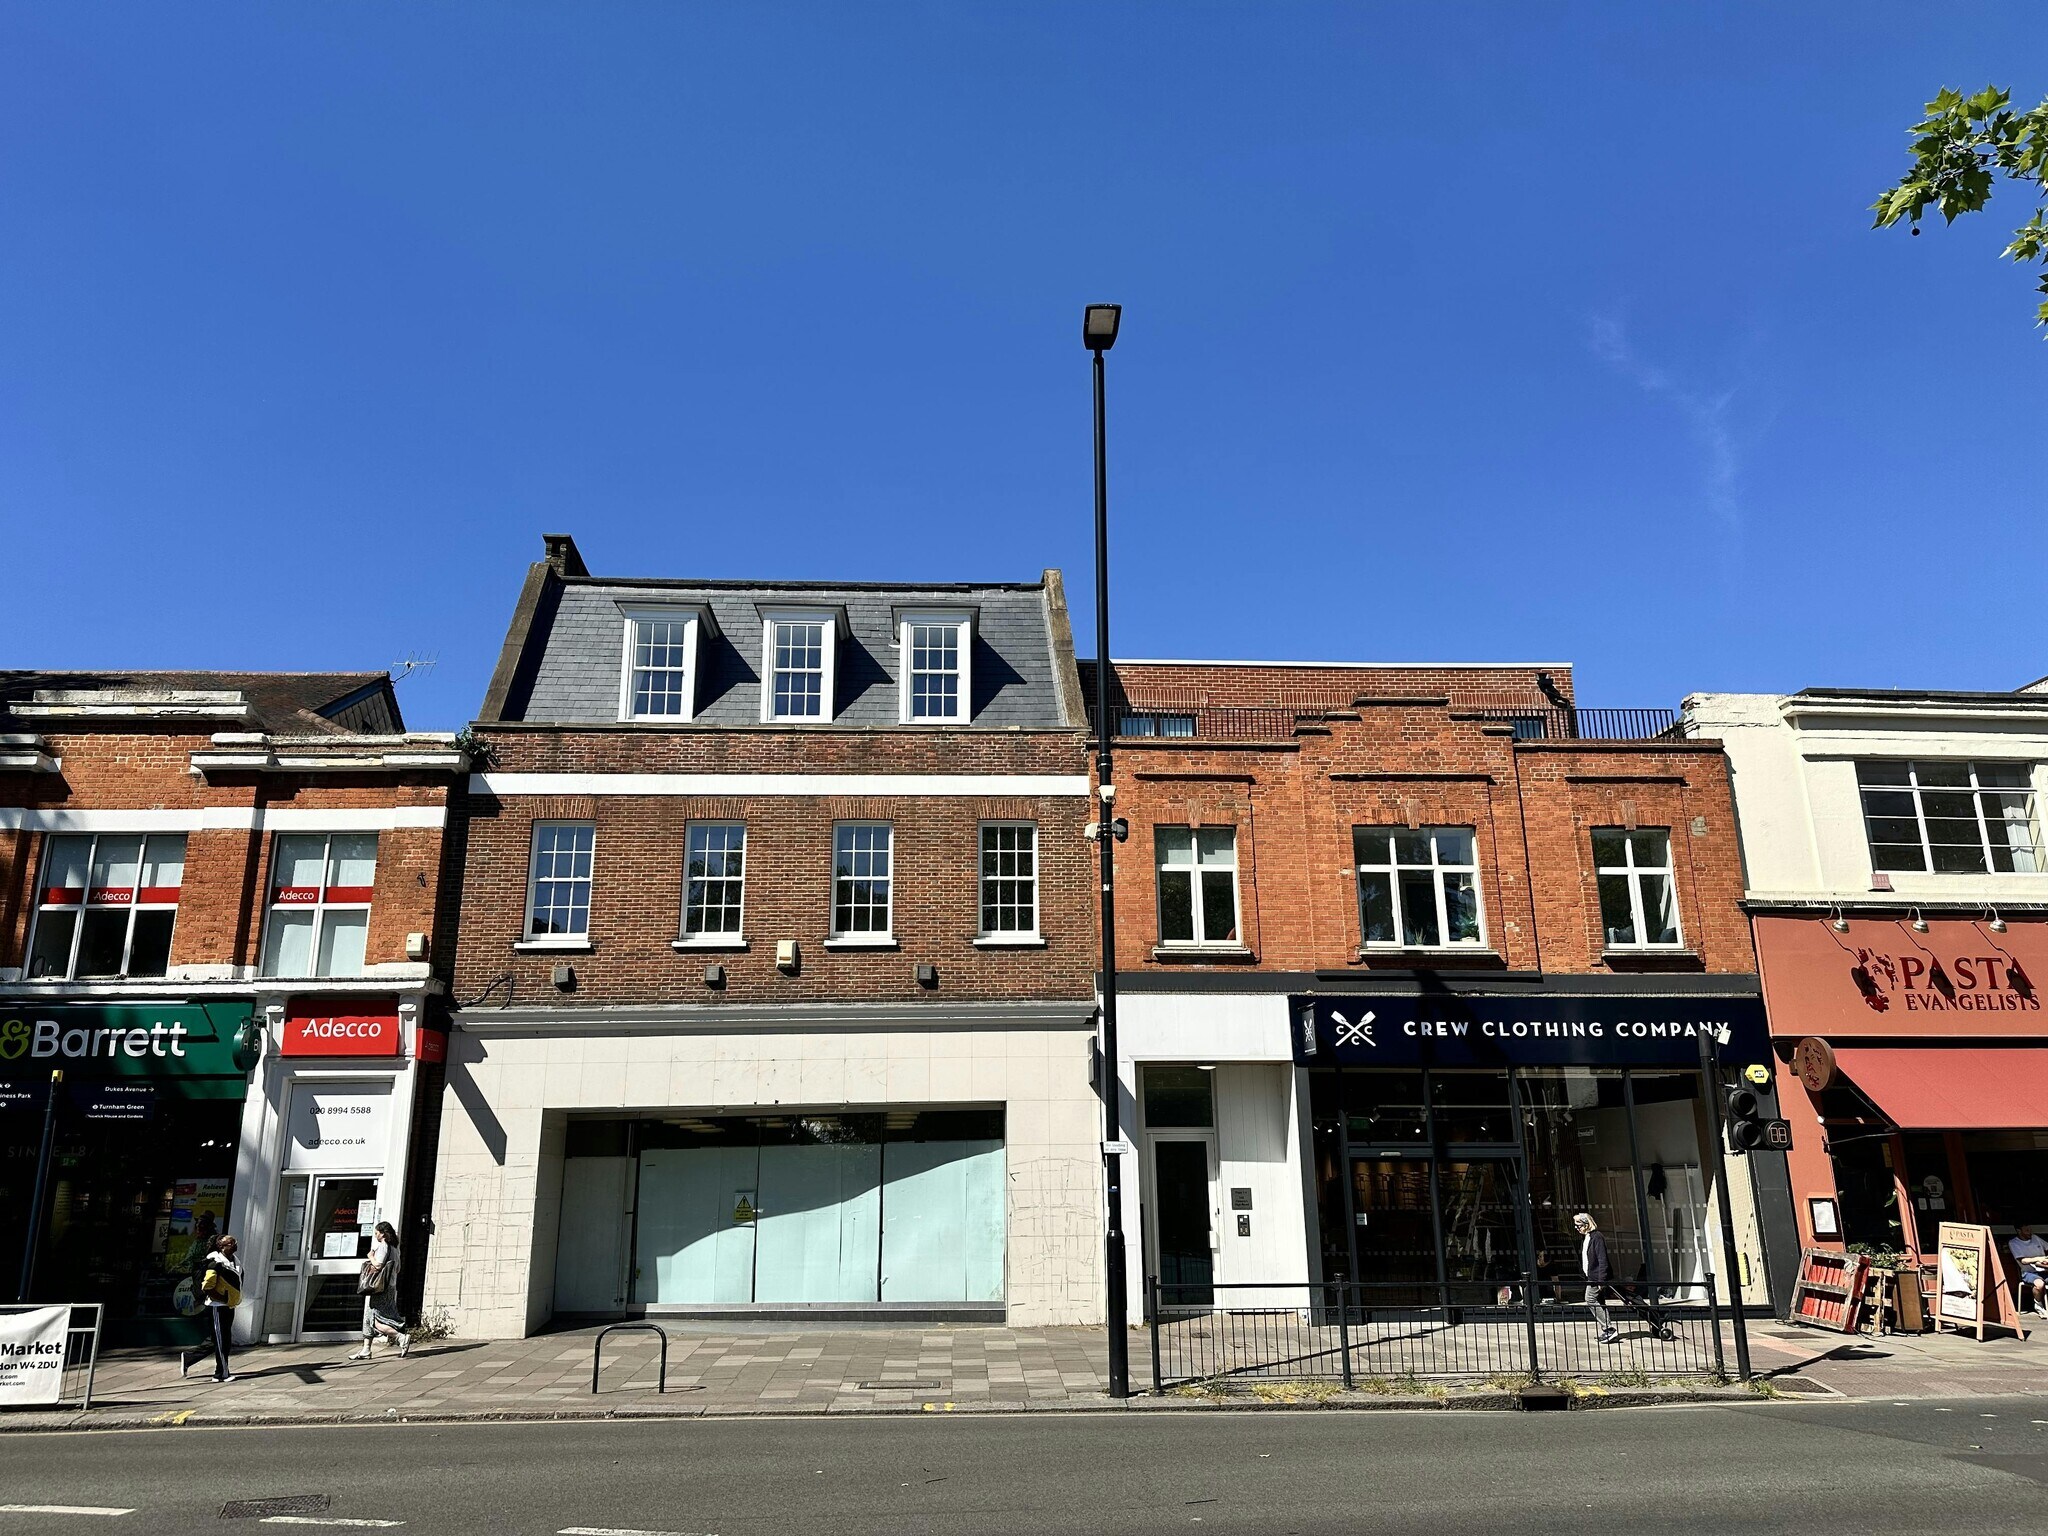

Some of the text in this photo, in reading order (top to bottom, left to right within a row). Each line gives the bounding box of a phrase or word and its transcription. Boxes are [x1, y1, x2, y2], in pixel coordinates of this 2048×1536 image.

[93, 890, 130, 901] Adecco
[279, 890, 314, 901] Adecco
[1898, 955, 2036, 990] PASTA
[1905, 993, 2041, 1011] EVANGELISTS
[301, 1018, 382, 1037] Adecco
[1403, 1021, 1469, 1036] CREW
[1482, 1021, 1604, 1037] CLOTHING
[31, 1020, 188, 1057] Barrett
[309, 1106, 372, 1115] 020 8994 5588
[308, 1137, 366, 1145] adecco.co.uk
[1, 1340, 63, 1356] Market
[20, 1361, 36, 1370] W4
[37, 1361, 58, 1369] 2DU
